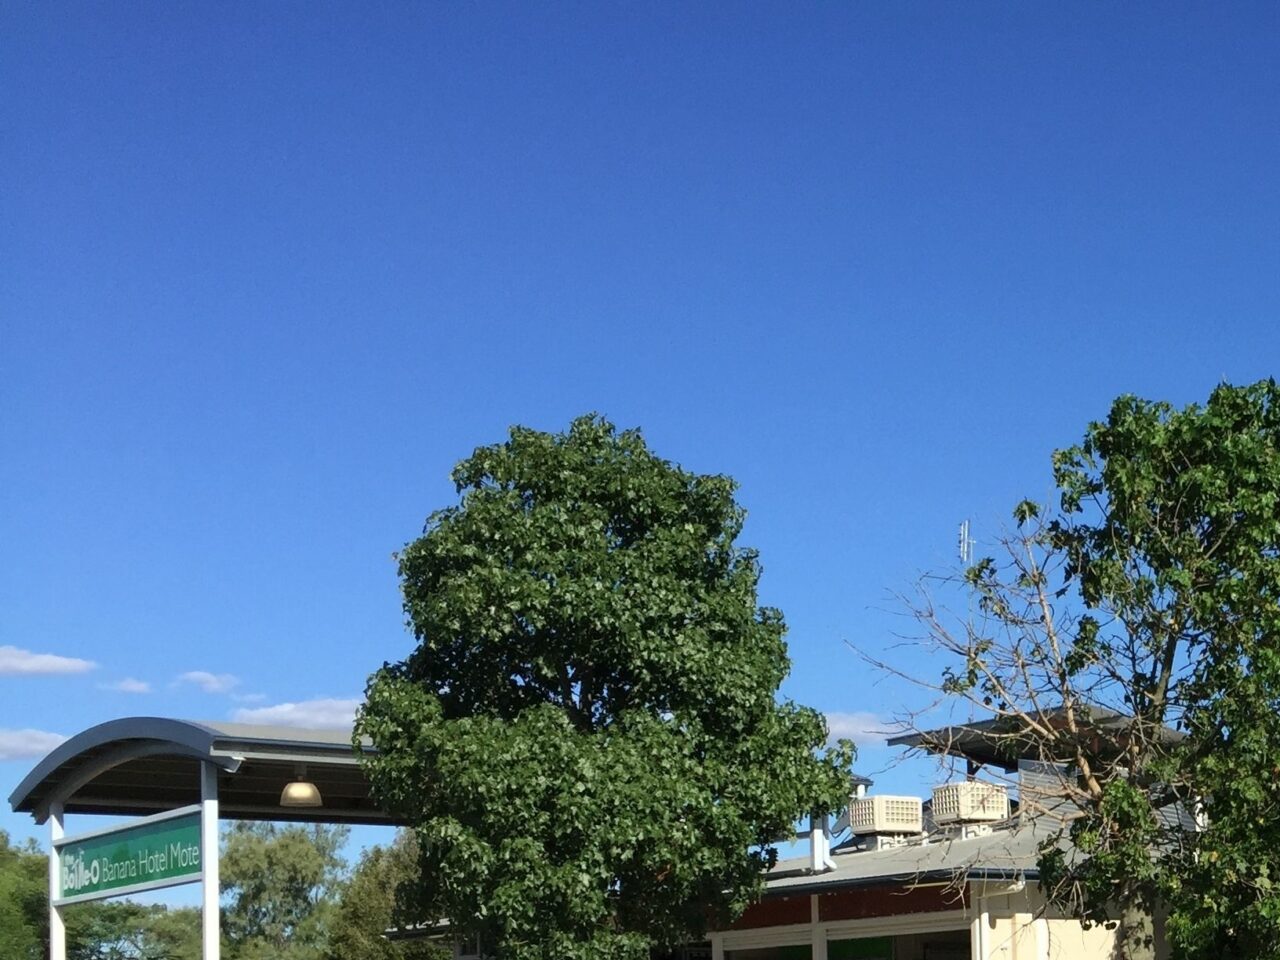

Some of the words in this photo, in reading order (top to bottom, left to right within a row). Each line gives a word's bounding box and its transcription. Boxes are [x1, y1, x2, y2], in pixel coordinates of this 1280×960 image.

[103, 857, 136, 882] Banana
[139, 844, 168, 875] Hotel
[170, 842, 199, 869] Mote
